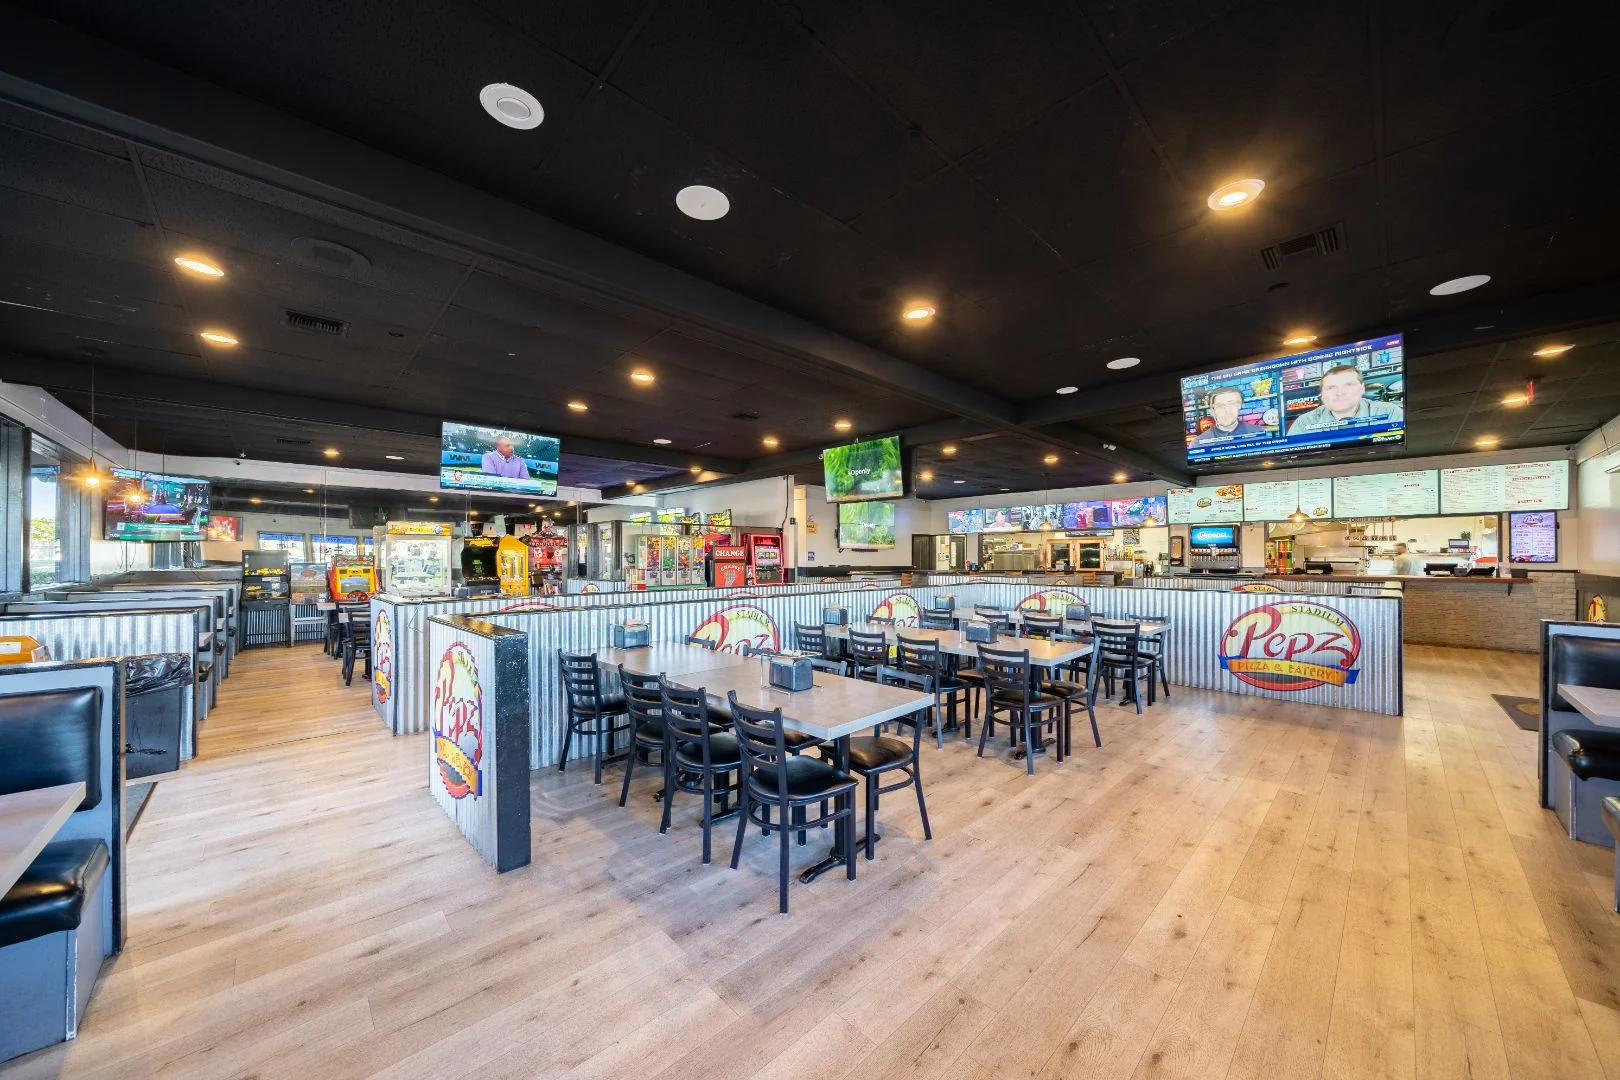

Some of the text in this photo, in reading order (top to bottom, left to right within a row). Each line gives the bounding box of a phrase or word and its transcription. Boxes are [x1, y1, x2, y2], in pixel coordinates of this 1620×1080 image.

[1290, 358, 1307, 366] WITH
[1291, 605, 1344, 627] STADIUM
[1229, 604, 1354, 668] Pepz
[1238, 661, 1333, 681] PIZZA & EATERY
